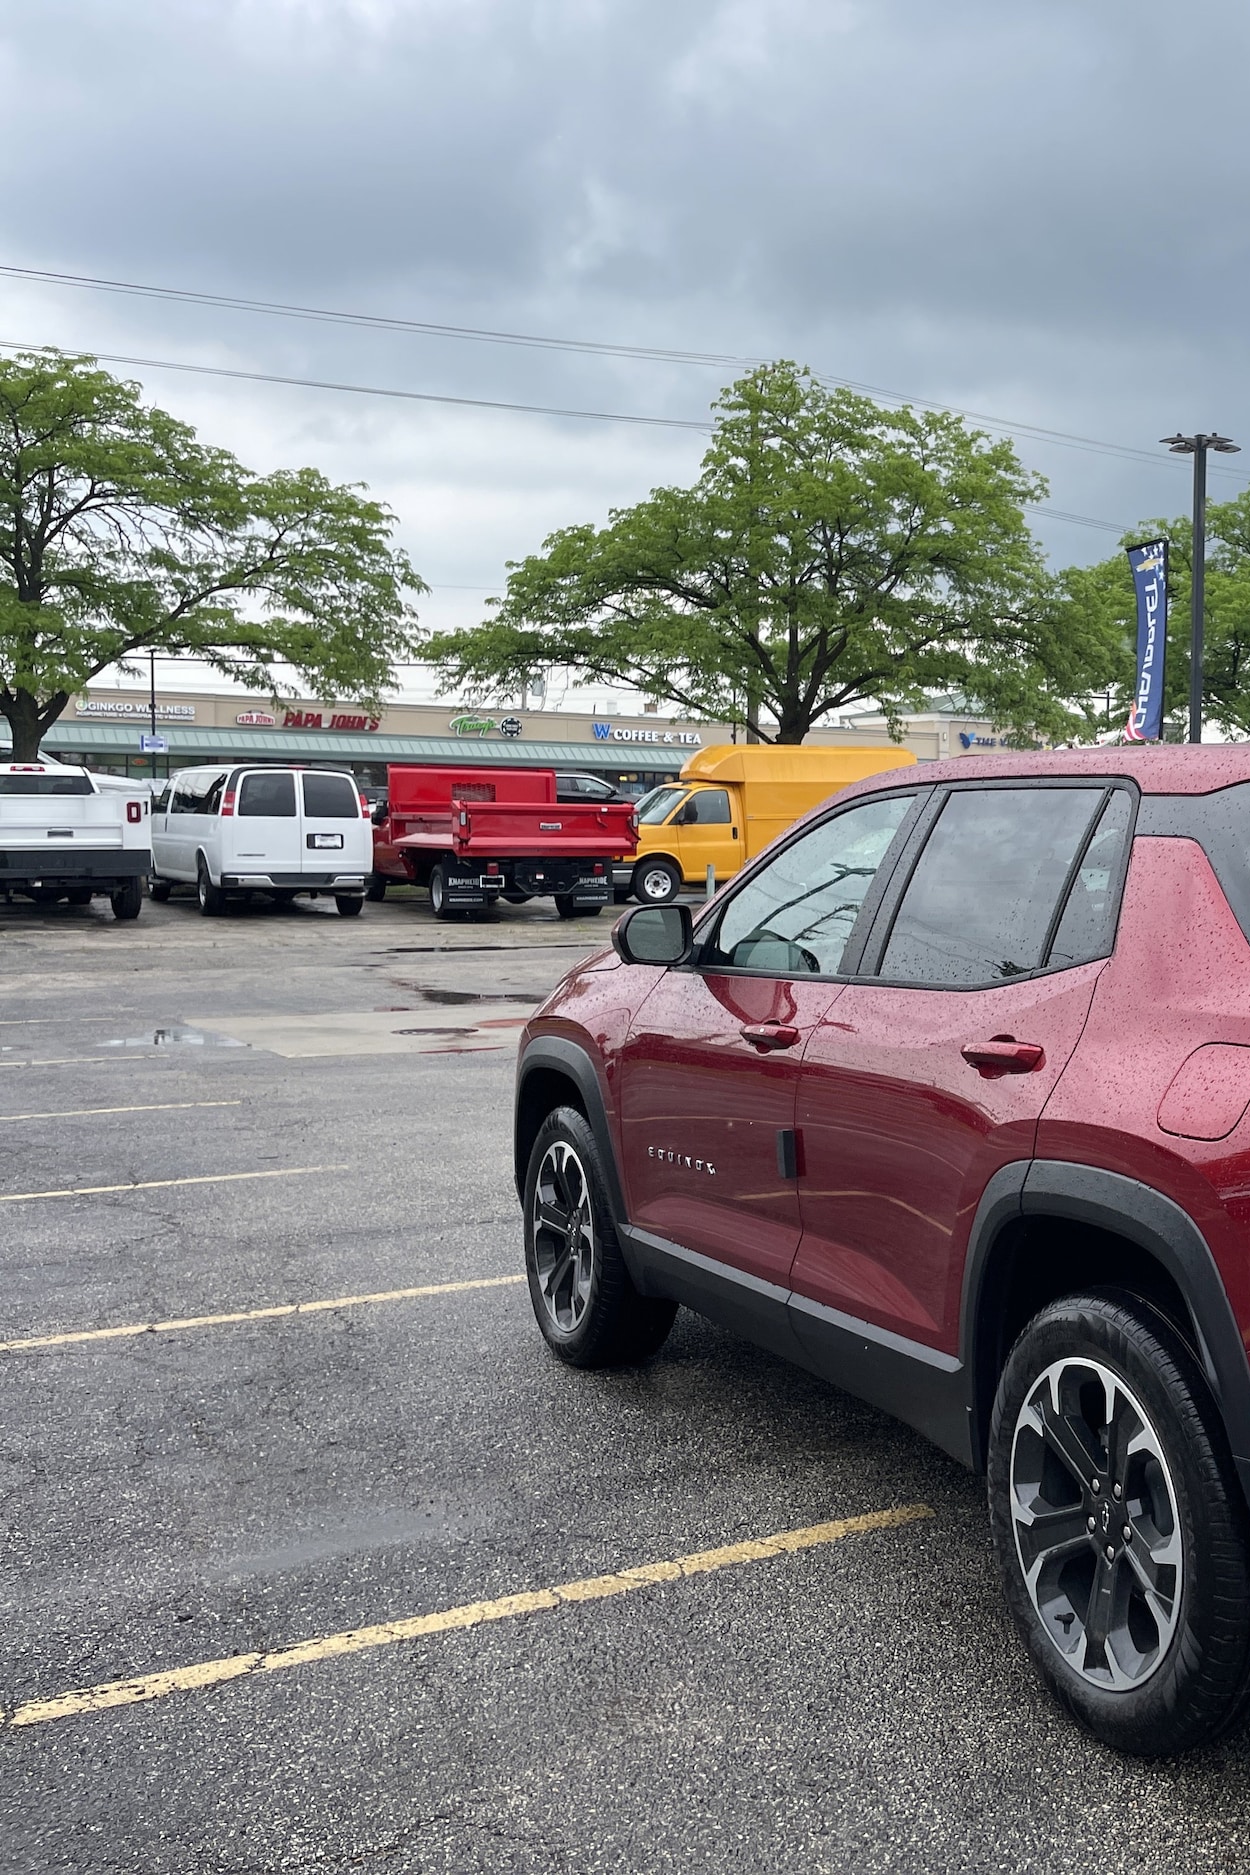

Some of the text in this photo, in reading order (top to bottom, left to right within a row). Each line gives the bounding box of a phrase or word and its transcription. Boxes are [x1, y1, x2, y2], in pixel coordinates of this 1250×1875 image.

[88, 701, 133, 712] GINKGO
[283, 711, 323, 727] PAPA
[593, 723, 702, 744] W COFFEE & TEA
[976, 737, 996, 746] THE
[448, 877, 480, 886] KNAPHEID
[579, 876, 608, 885] NAPHEIDE
